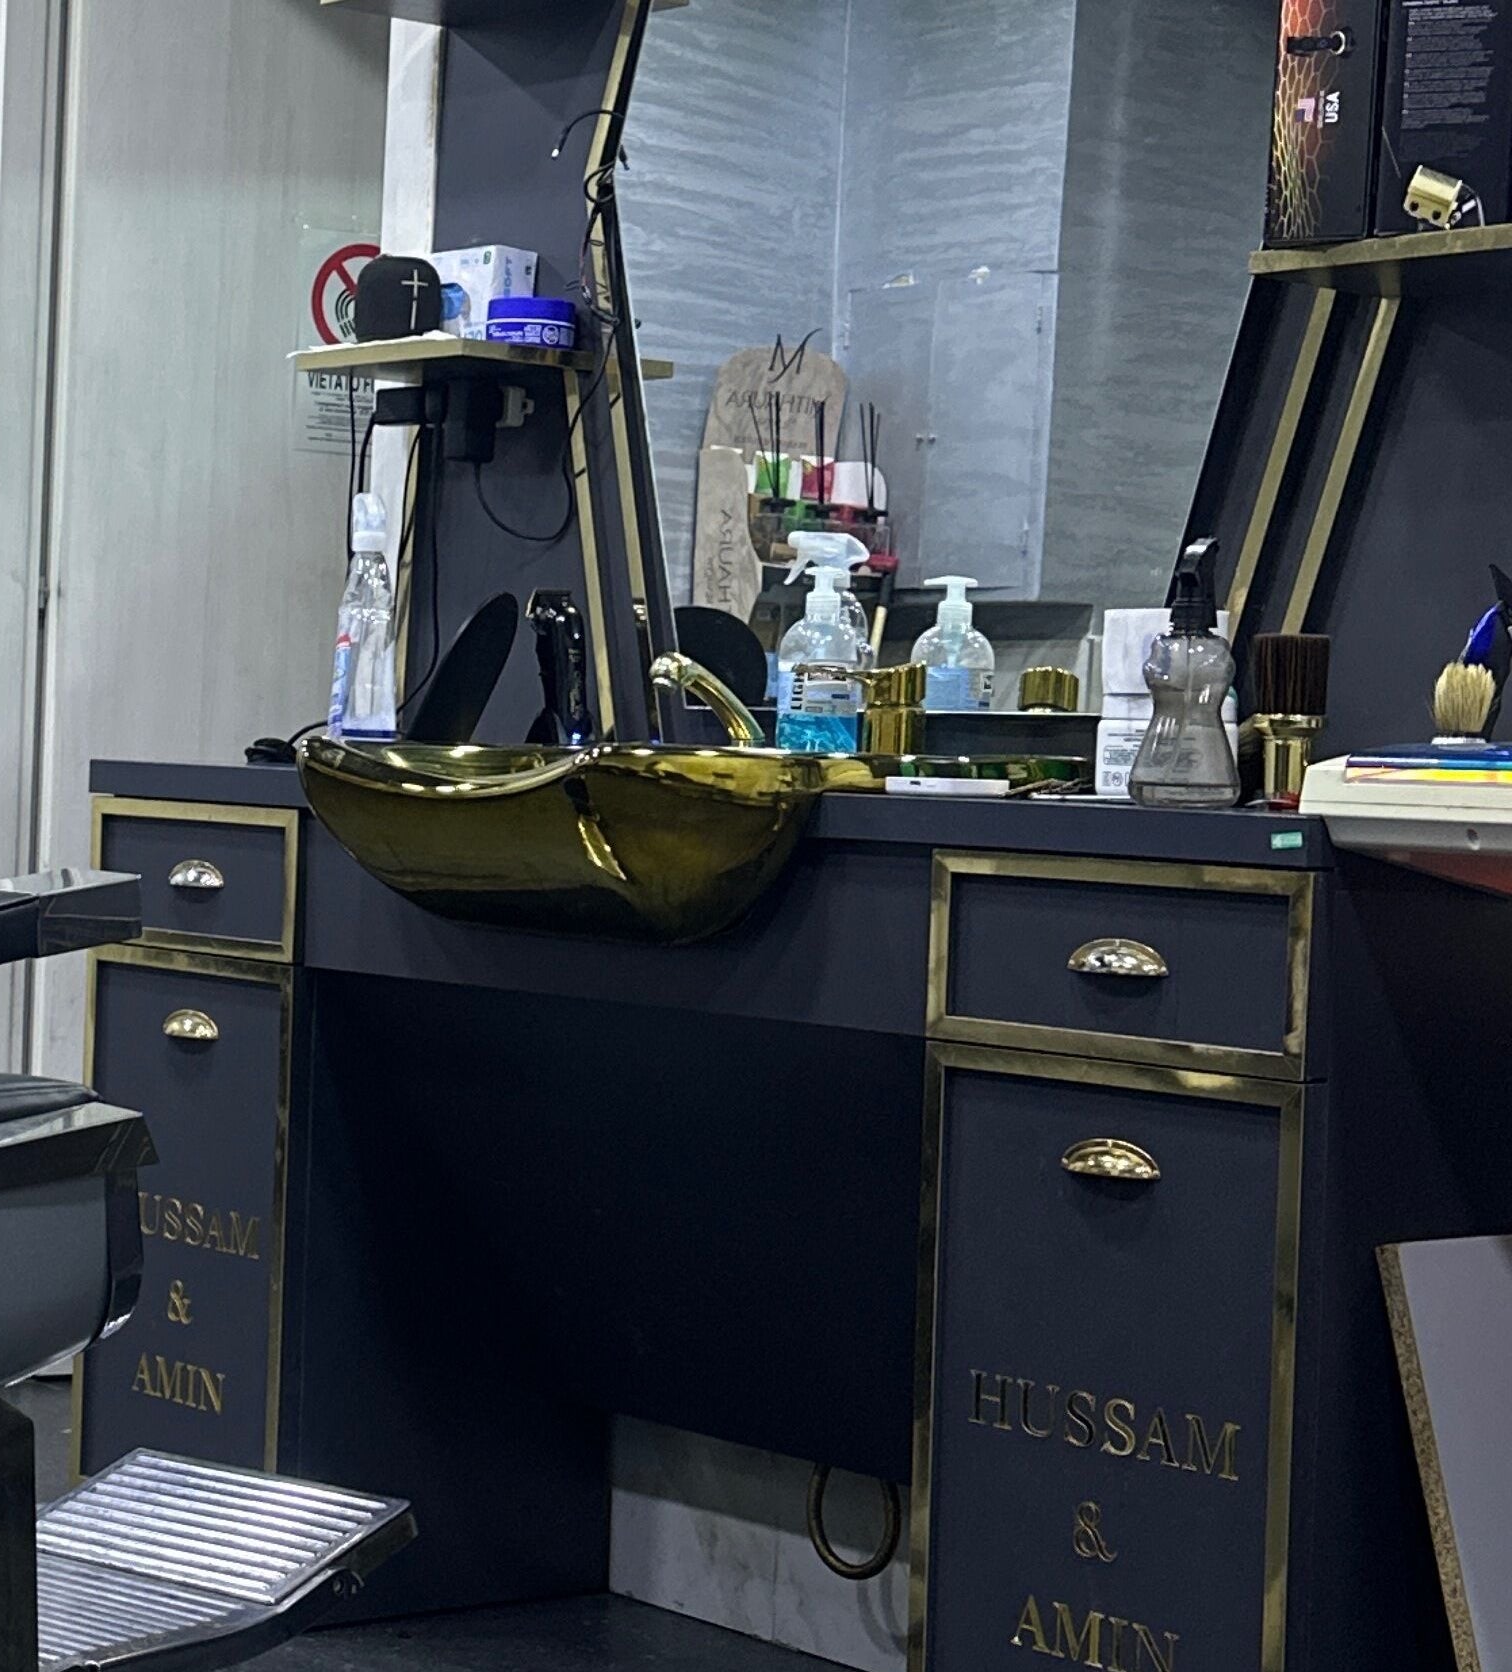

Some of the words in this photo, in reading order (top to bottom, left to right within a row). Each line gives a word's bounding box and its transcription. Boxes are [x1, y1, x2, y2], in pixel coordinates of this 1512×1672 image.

[1324, 91, 1340, 123] USA
[137, 1191, 261, 1261] USSAM
[167, 1279, 193, 1325] &
[131, 1351, 227, 1416] AMIN
[967, 1368, 1242, 1482] HUSSAM
[1072, 1500, 1118, 1563] &
[1009, 1594, 1181, 1672] AMIN
